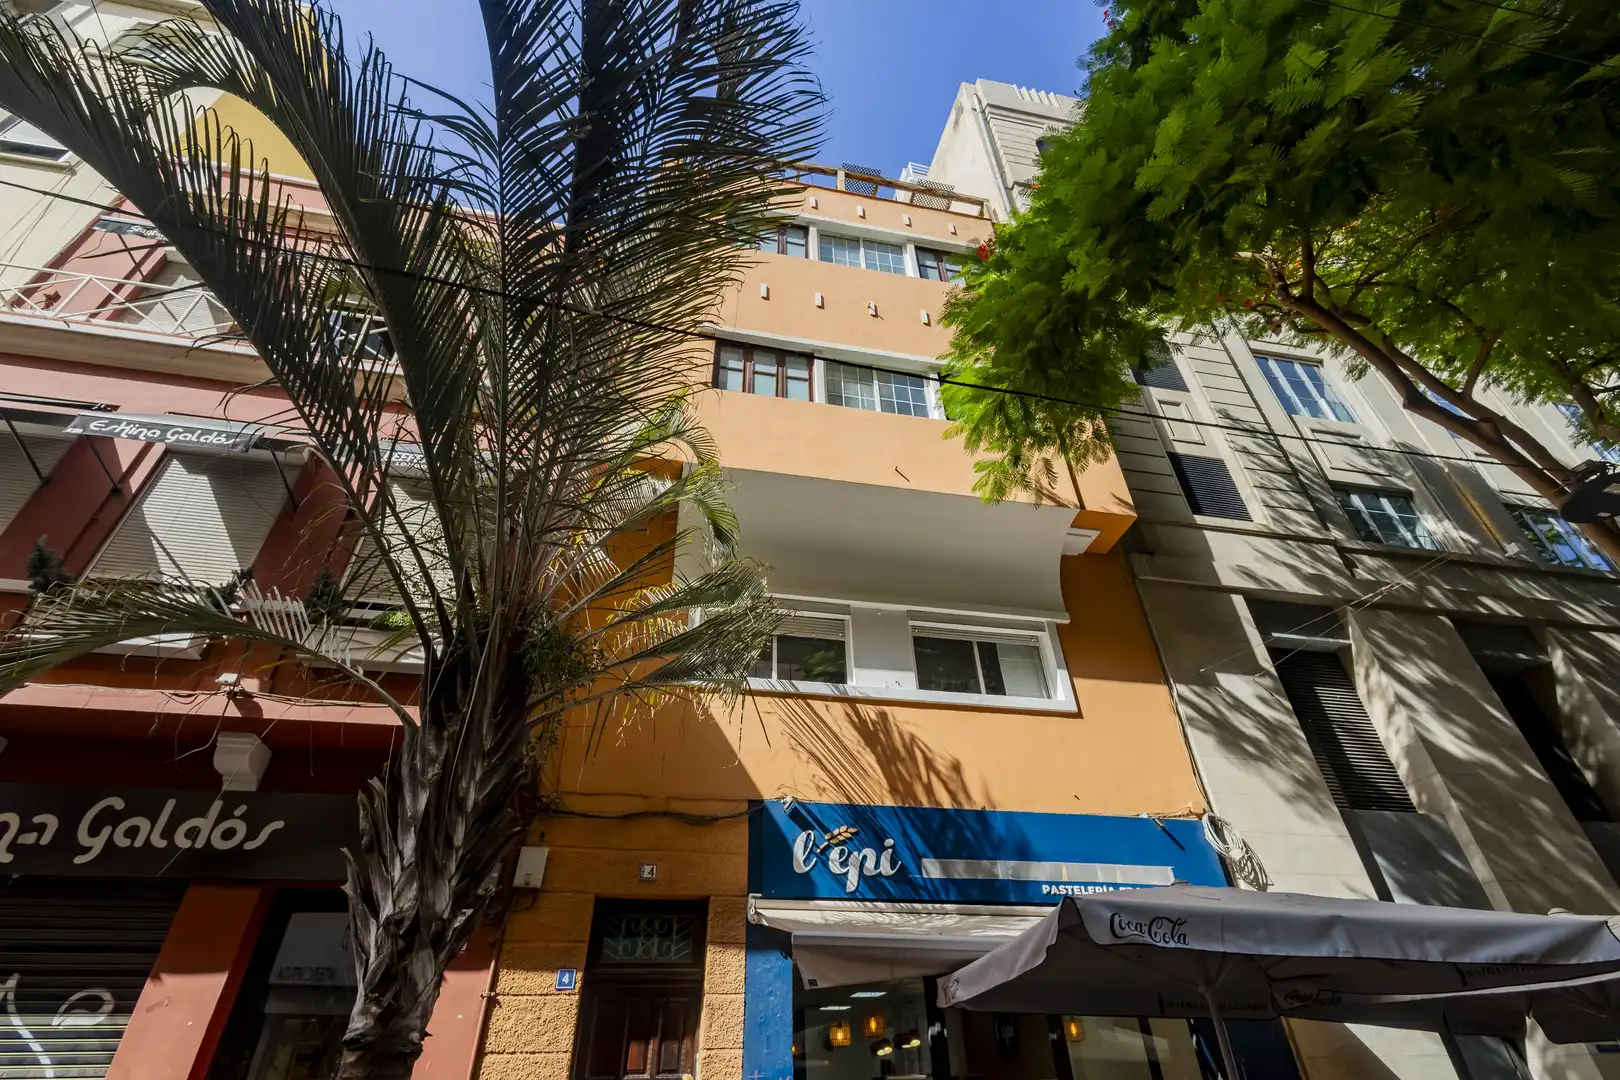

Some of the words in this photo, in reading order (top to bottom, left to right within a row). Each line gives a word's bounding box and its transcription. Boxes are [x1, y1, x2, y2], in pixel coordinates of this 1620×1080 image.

[73, 796, 285, 864] Galdós
[1110, 913, 1189, 945] Coca-Cola
[561, 972, 570, 987] 4
